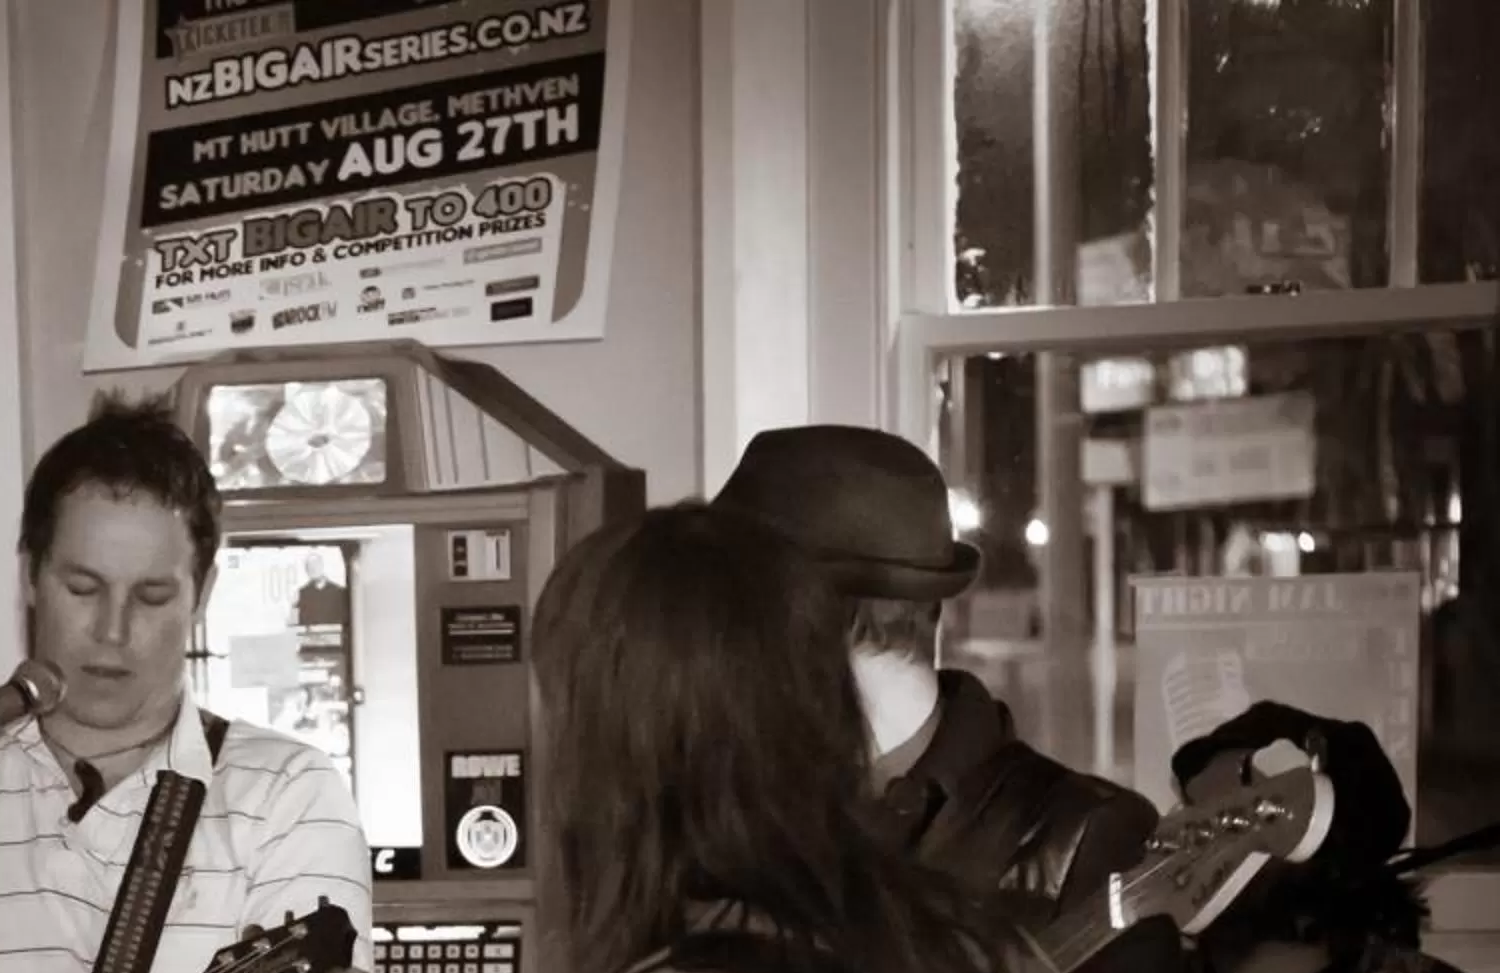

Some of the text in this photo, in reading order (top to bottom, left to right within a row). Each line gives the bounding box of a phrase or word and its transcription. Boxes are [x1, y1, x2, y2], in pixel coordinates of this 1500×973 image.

[167, 3, 588, 107] NZBIGAIRSERIES.CO.NZ
[159, 104, 579, 210] SATURDAY AUG 27TH
[192, 136, 234, 163] MT
[240, 122, 314, 155] HUTT
[447, 73, 579, 117] METHVEN
[155, 177, 553, 272] TXT BIGAIR TO 400
[155, 271, 193, 289] FOR
[200, 259, 253, 282] MORE
[259, 252, 306, 273] INFO
[312, 248, 327, 263] &
[333, 225, 473, 260] COMPETITION
[479, 212, 546, 237] PRIZES
